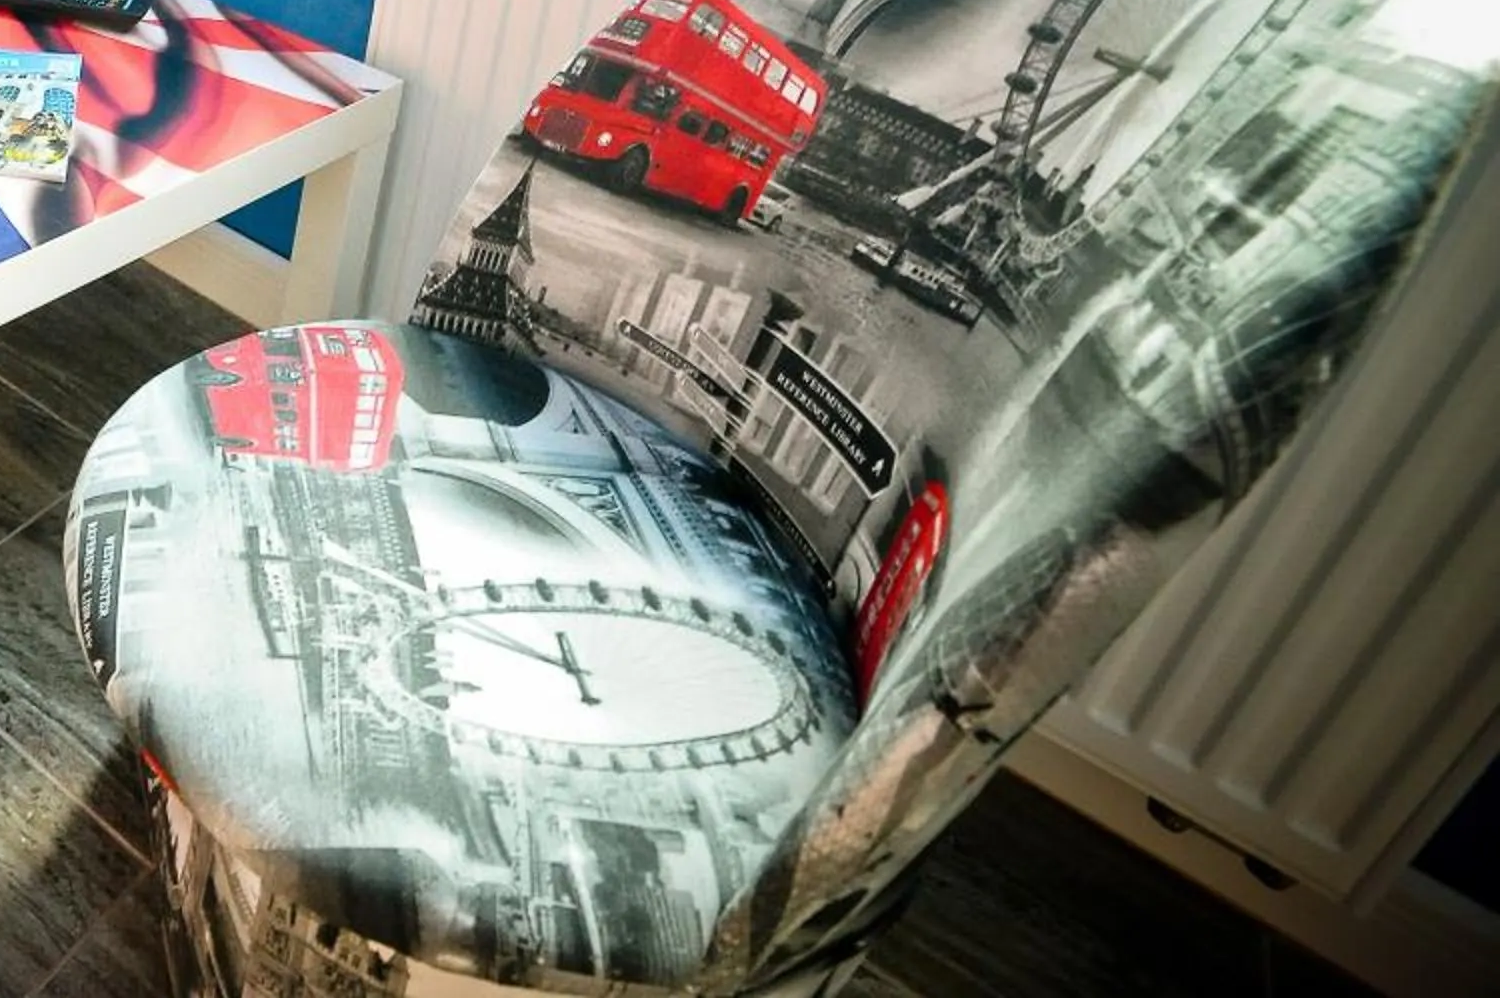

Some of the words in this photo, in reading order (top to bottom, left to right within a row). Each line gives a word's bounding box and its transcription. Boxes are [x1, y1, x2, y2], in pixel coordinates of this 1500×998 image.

[776, 371, 830, 427] REFERENCE
[830, 422, 867, 465] LIBRARY
[802, 370, 863, 436] WESTMINSTER
